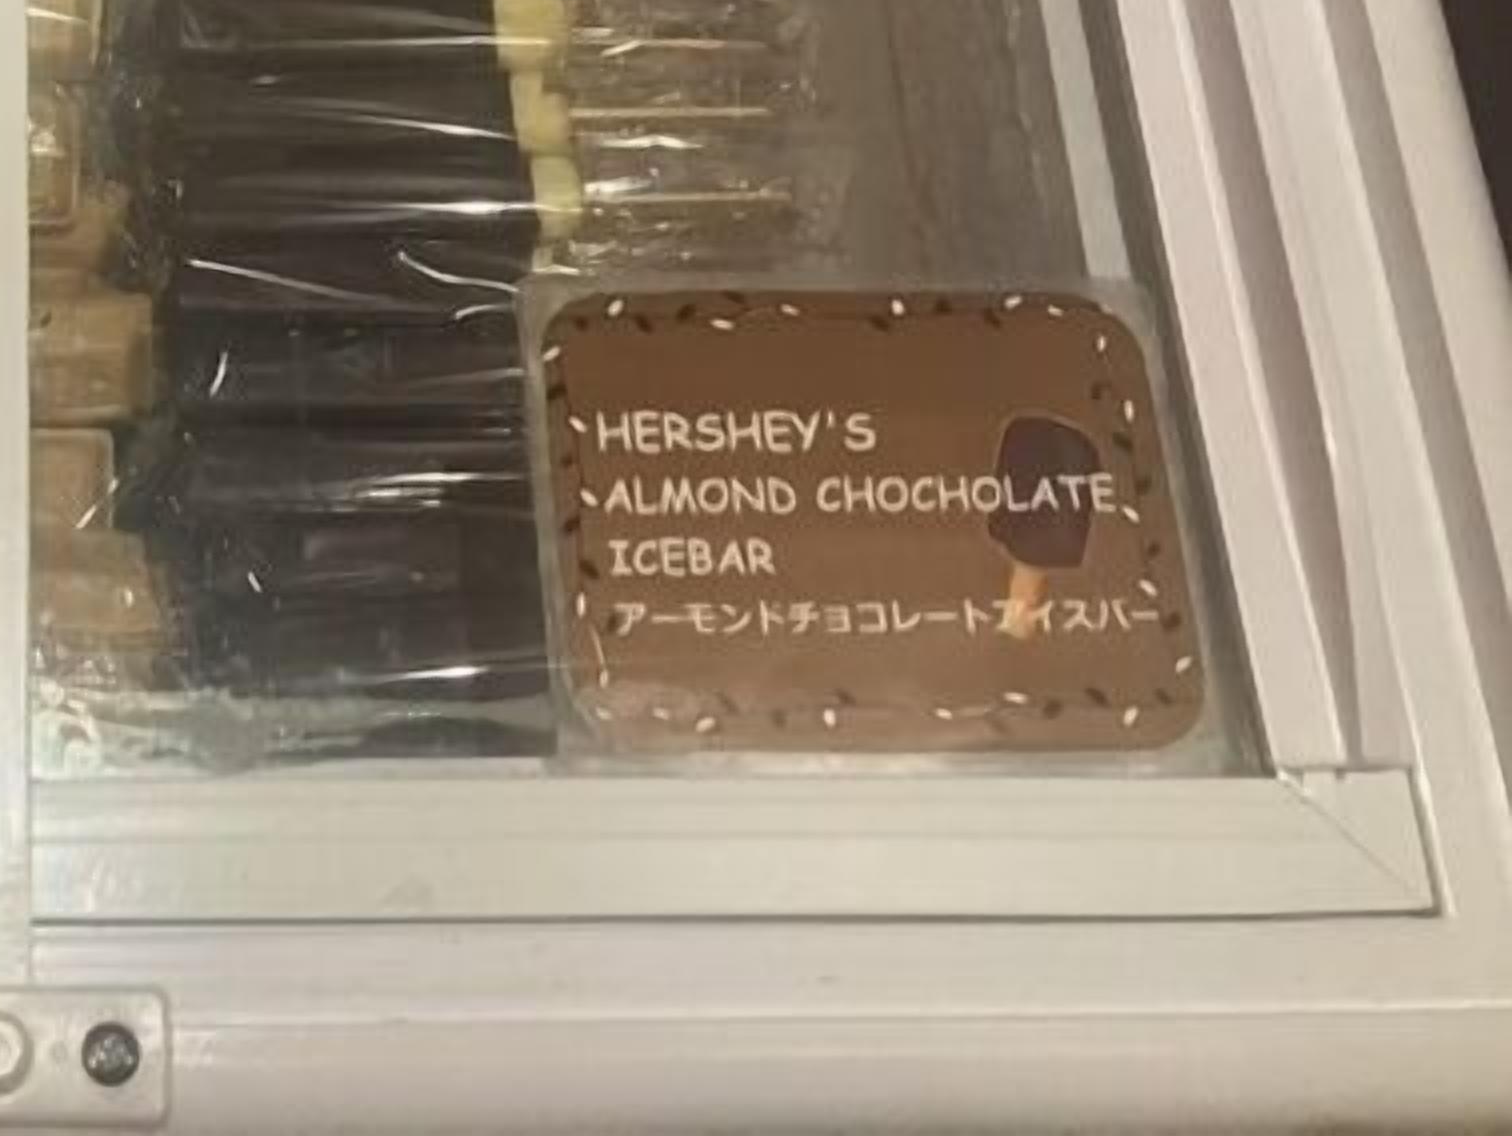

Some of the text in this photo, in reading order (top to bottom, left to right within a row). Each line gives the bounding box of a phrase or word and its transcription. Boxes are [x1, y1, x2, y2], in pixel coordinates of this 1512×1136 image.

[596, 408, 877, 453] HERSHEY'S
[604, 472, 1117, 516] ALMOND CHOCHOLATE
[609, 537, 777, 577] ICEBAR
[614, 598, 1160, 636] アーモンドチョコレートアイスバー
